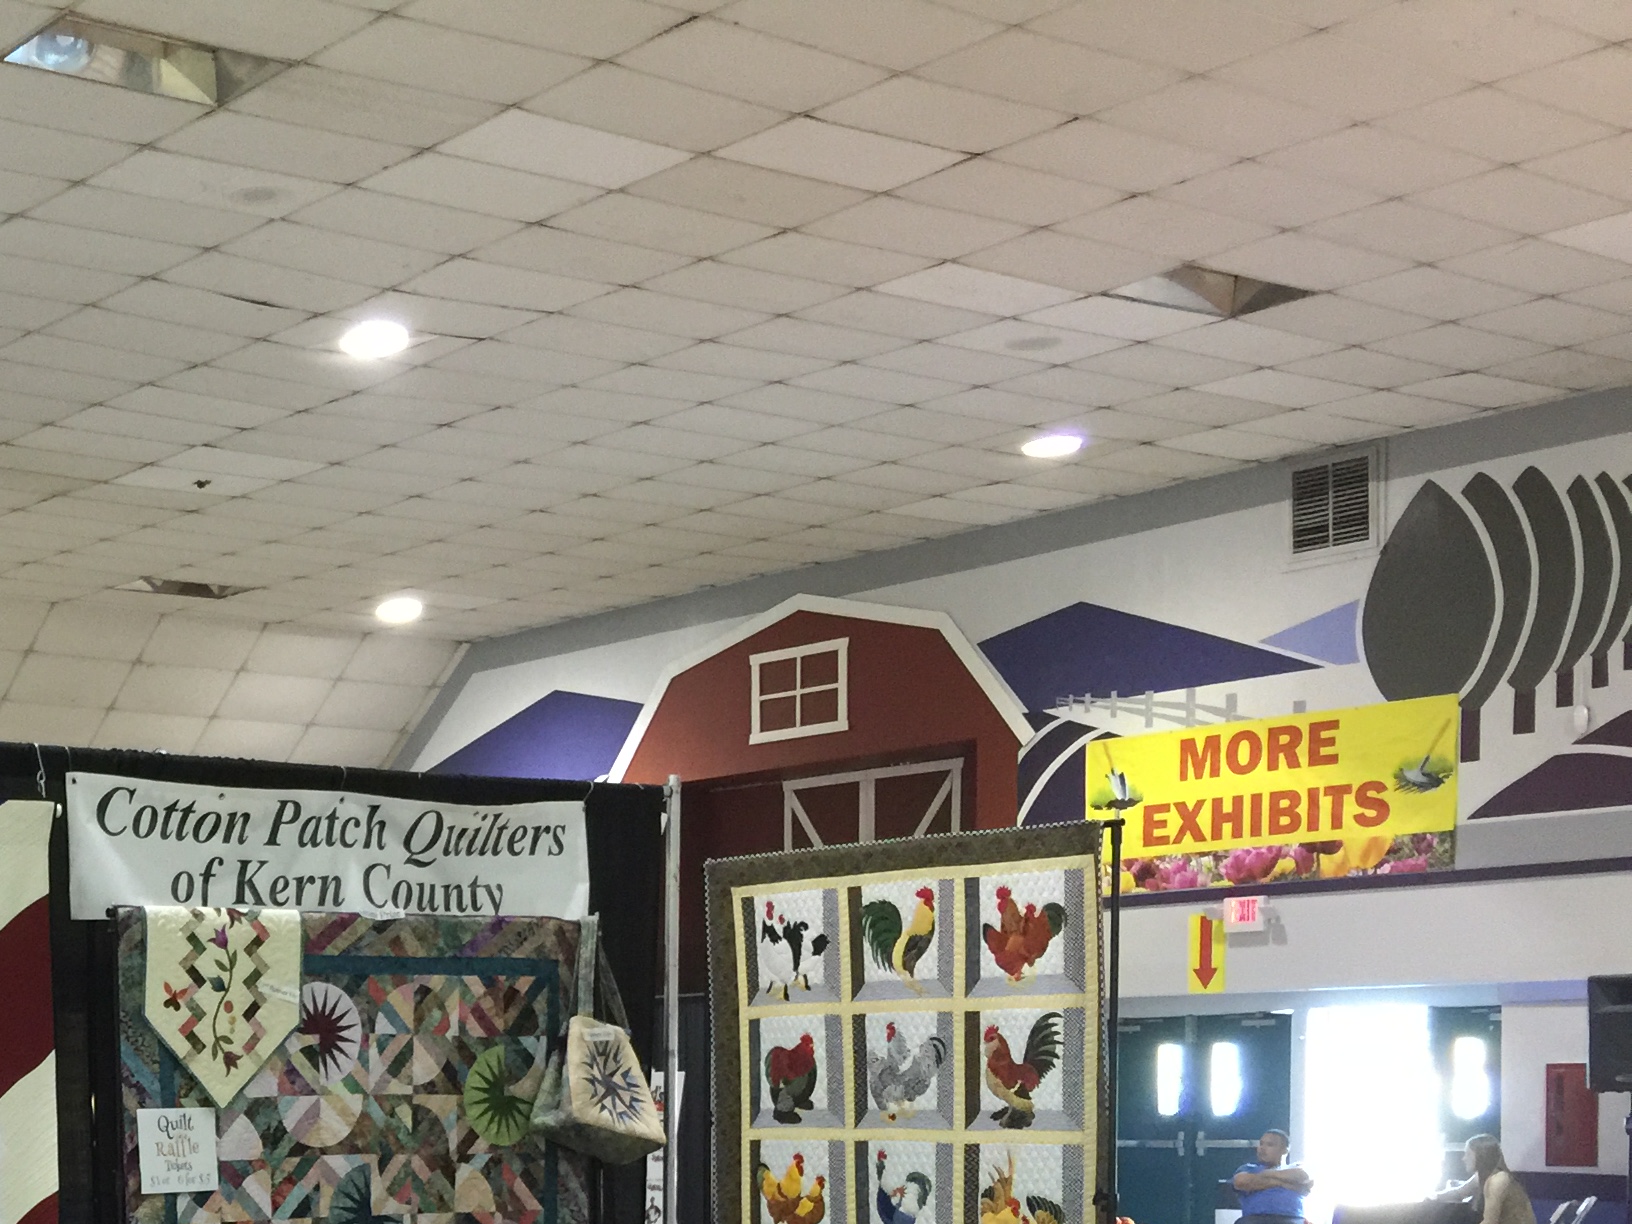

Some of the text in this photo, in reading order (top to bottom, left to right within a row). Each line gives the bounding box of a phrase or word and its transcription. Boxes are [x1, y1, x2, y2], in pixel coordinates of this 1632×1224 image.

[1179, 719, 1340, 782] MORE
[95, 786, 567, 868] Cotton Patch Quilters
[1142, 780, 1391, 847] EXHIBITS
[171, 856, 505, 916] of Kern County
[155, 1134, 200, 1157] Raffle
[157, 1113, 194, 1139] Quilt
